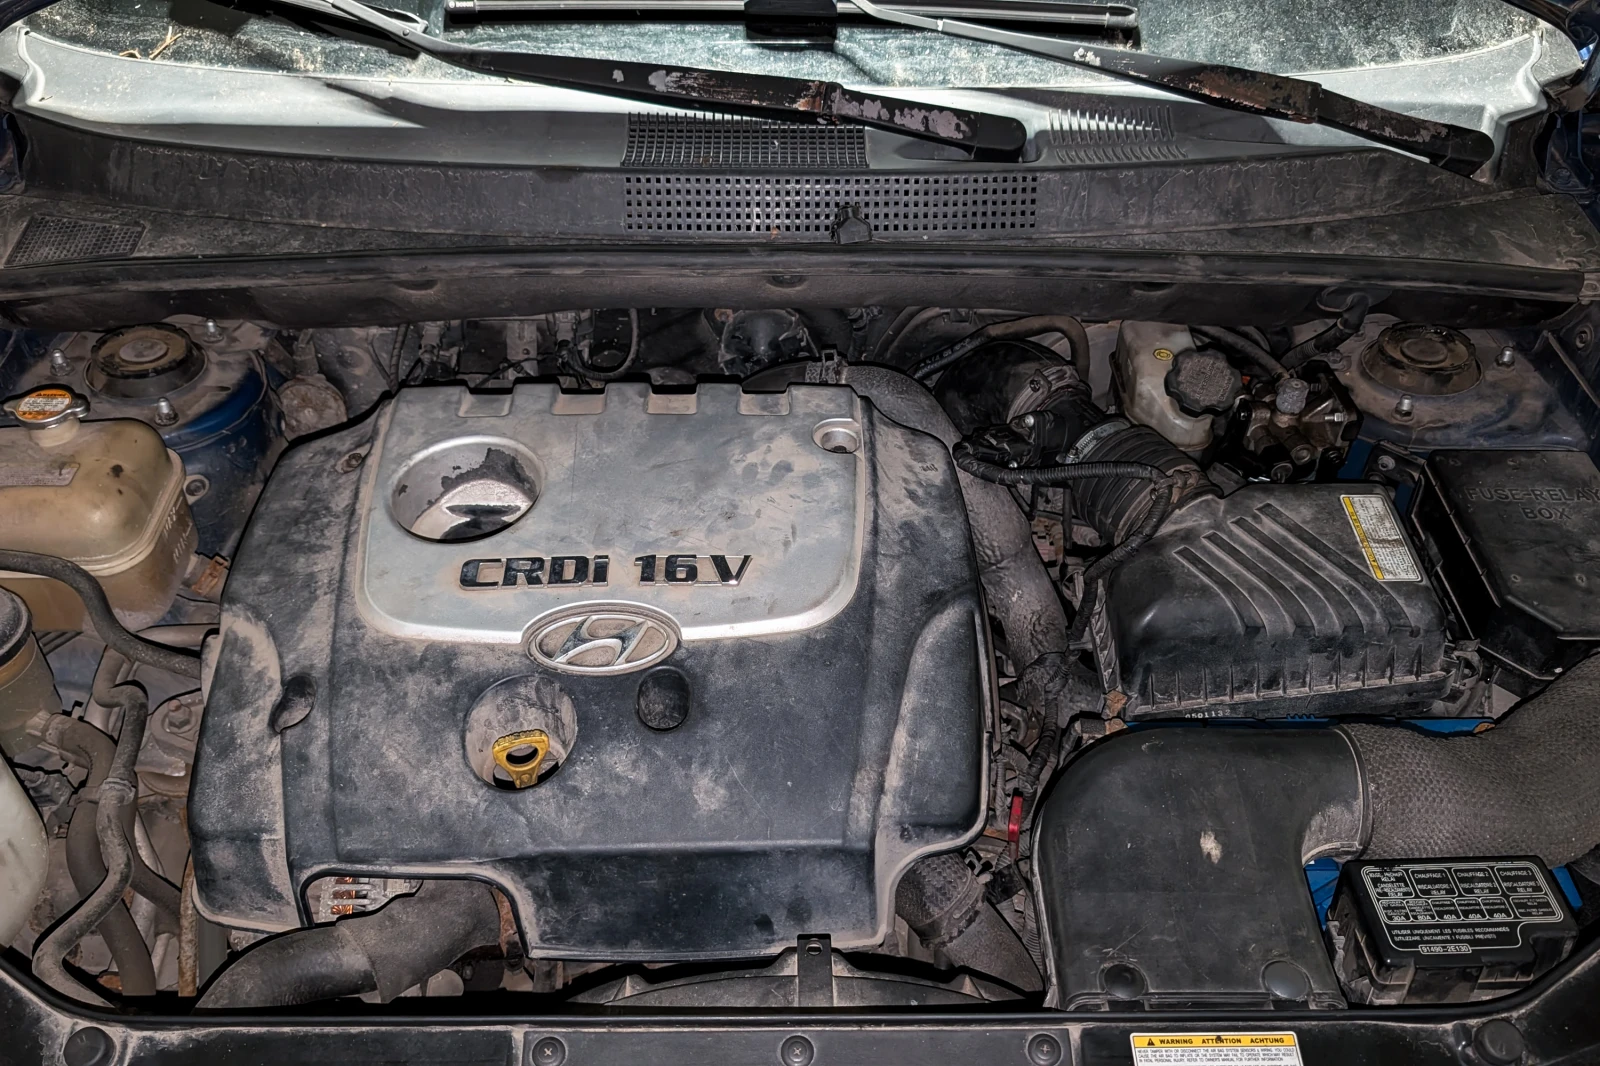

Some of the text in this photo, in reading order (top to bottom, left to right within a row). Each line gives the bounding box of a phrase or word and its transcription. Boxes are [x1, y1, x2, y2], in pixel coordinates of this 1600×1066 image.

[1464, 487, 1600, 502] FUSE-RELAY
[1520, 507, 1573, 521] BOX
[459, 554, 611, 590] CRDi
